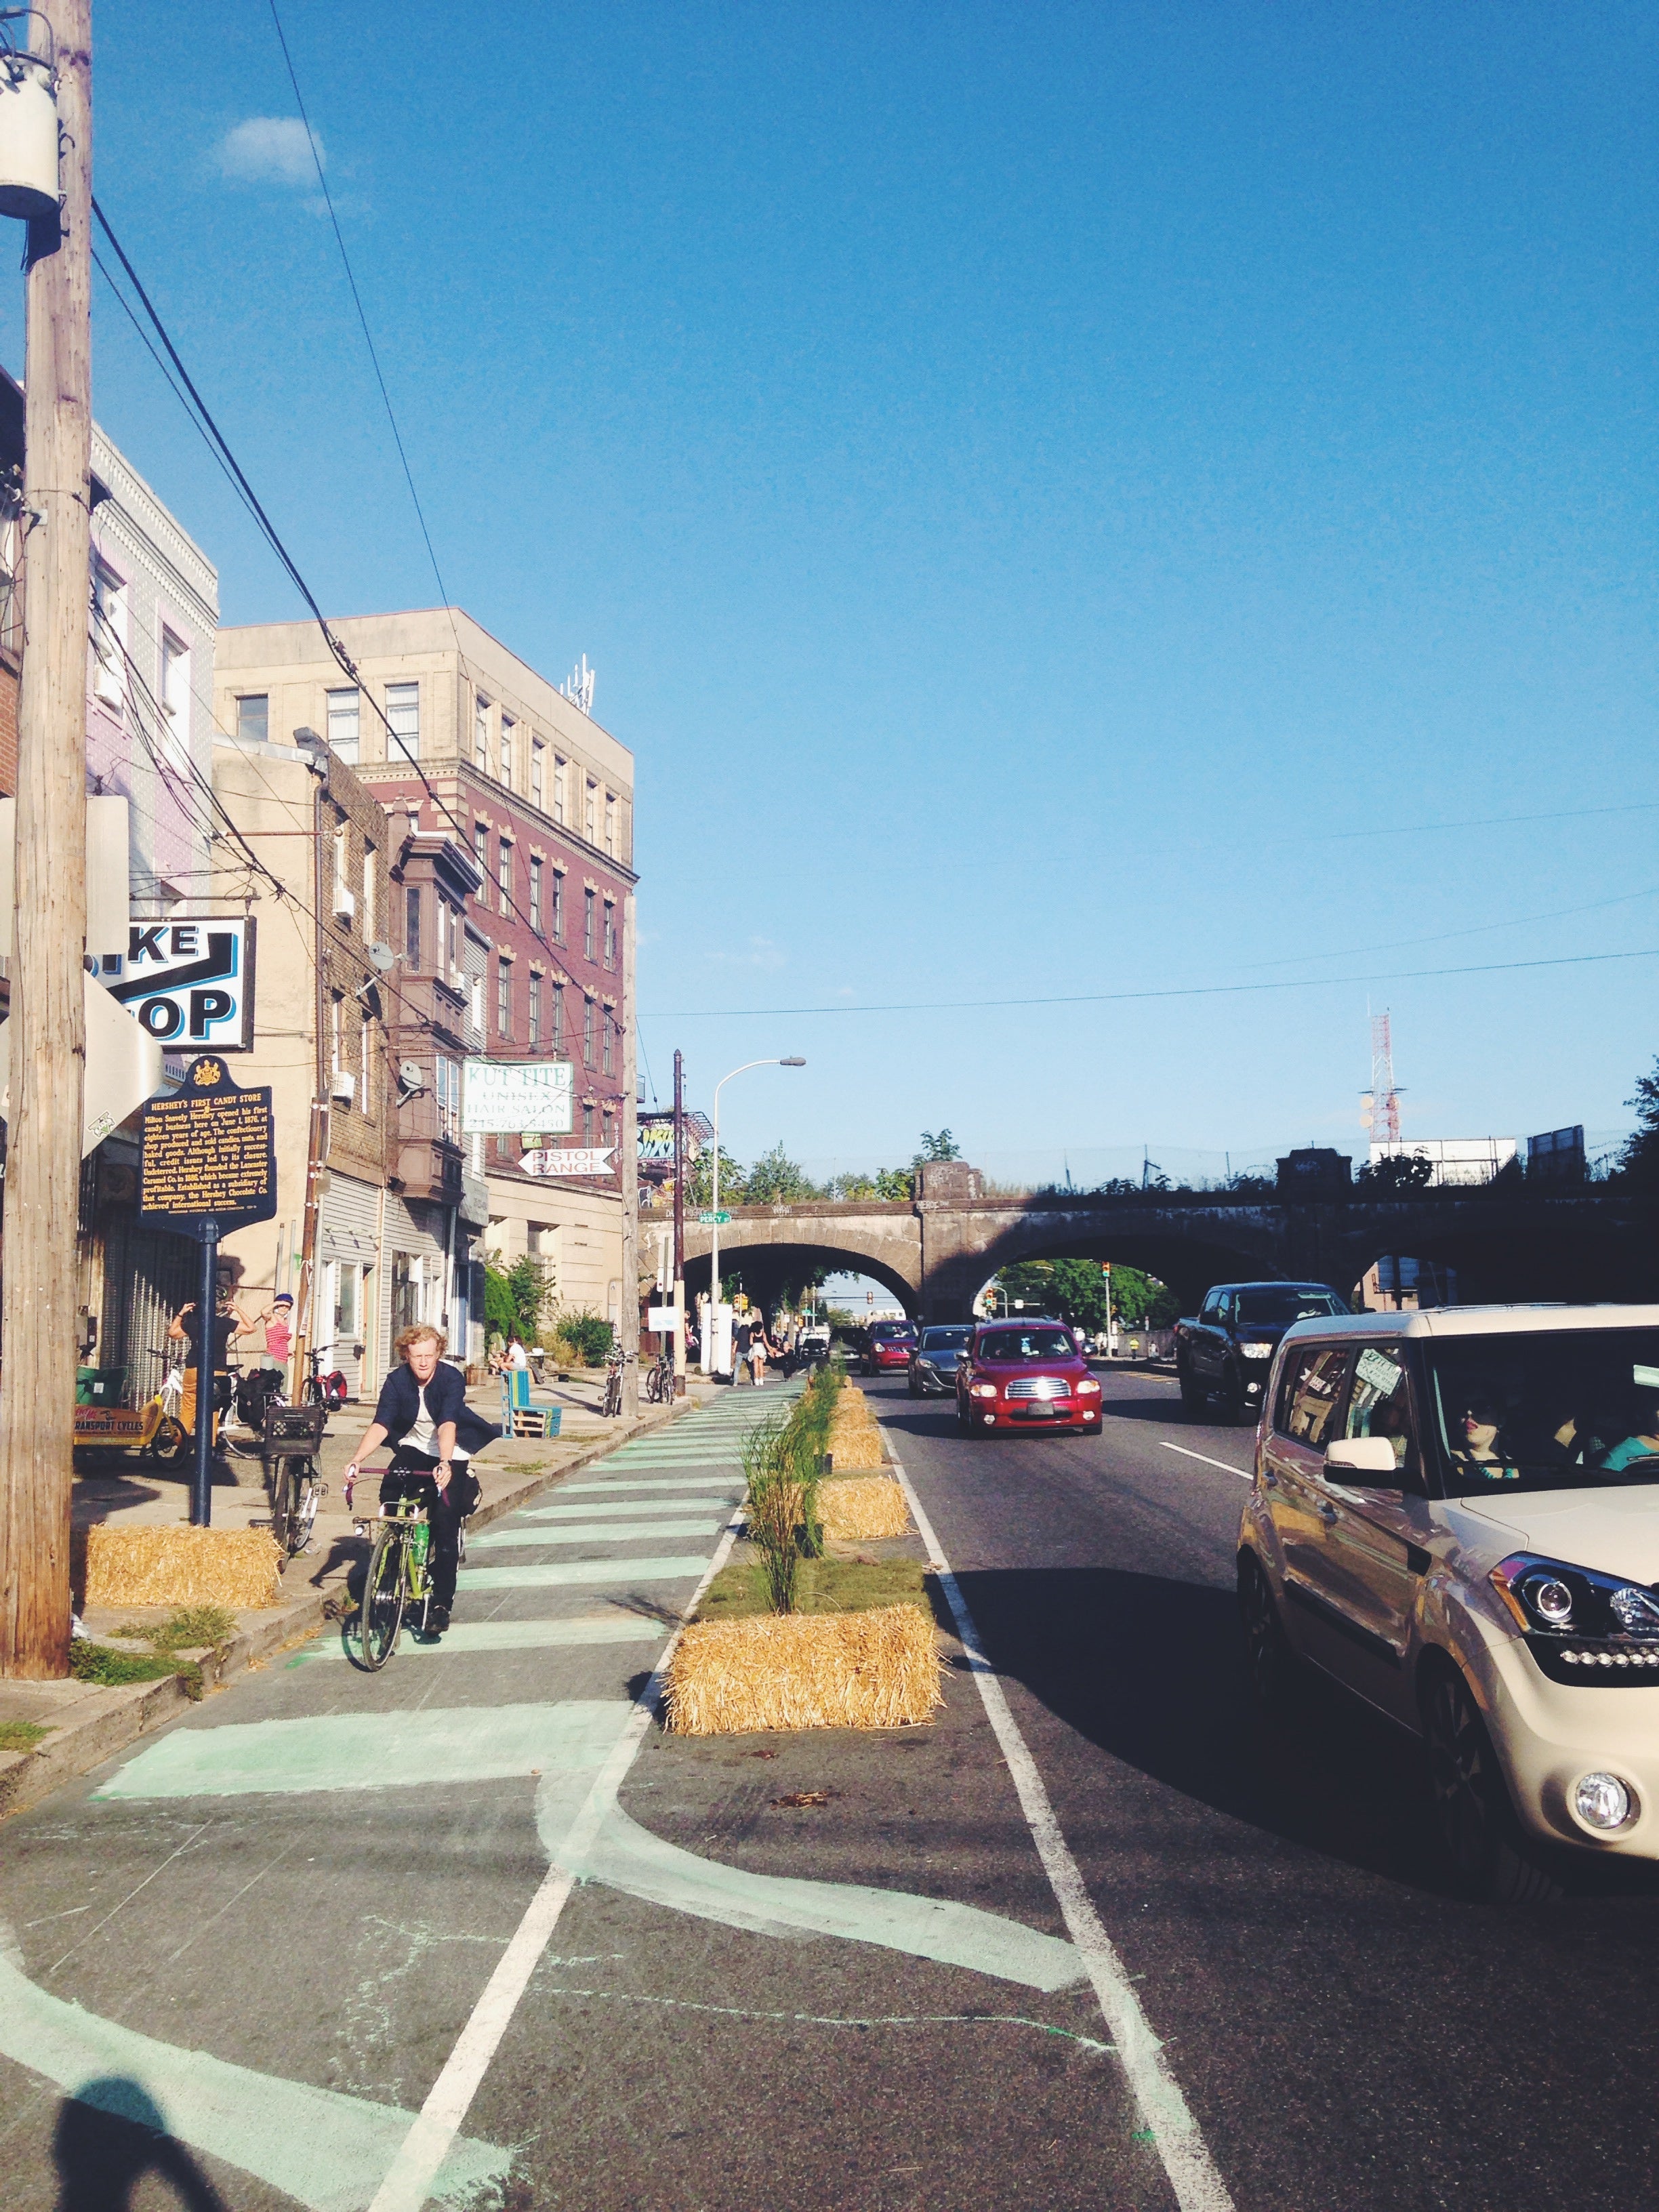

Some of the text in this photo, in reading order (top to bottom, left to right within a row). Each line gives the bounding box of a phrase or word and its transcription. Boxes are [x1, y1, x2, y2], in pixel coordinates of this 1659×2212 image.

[126, 989, 236, 1041] OP
[469, 1067, 565, 1086] KUT TITE
[152, 1093, 261, 1111] HERSHEY'S FIRST CANDY STORE
[483, 1092, 551, 1101] UNISEX
[468, 1105, 565, 1113] HAIR SALON
[165, 1113, 188, 1122] Snavely
[190, 1111, 214, 1120] Hershey
[218, 1109, 239, 1118] opened
[144, 1124, 162, 1133] candy
[144, 1133, 169, 1142] eighteen
[172, 1133, 188, 1141] years
[227, 1126, 267, 1134] confectionery
[161, 1139, 188, 1149] produced
[145, 1150, 162, 1158] baked
[165, 1149, 185, 1158] goods.
[188, 1147, 215, 1155] Although
[219, 1145, 241, 1153] initially
[533, 1151, 600, 1162] PISTOL
[179, 1166, 203, 1174] Hershey
[205, 1163, 227, 1171] founded
[241, 1160, 268, 1168] Lancaster
[533, 1162, 600, 1173] RANGE
[144, 1176, 165, 1184] Caramel
[200, 1172, 217, 1181] which
[241, 1168, 267, 1178] extremely
[144, 1185, 175, 1195] profitable.
[178, 1182, 211, 1191] Established
[228, 1179, 258, 1187] subsidiary
[202, 1190, 226, 1198] Hershey
[229, 1188, 255, 1196] Chocolate
[142, 1202, 169, 1210] achieved
[173, 1200, 211, 1208] international
[75, 1421, 143, 1430] RANSPORT CYCLES
